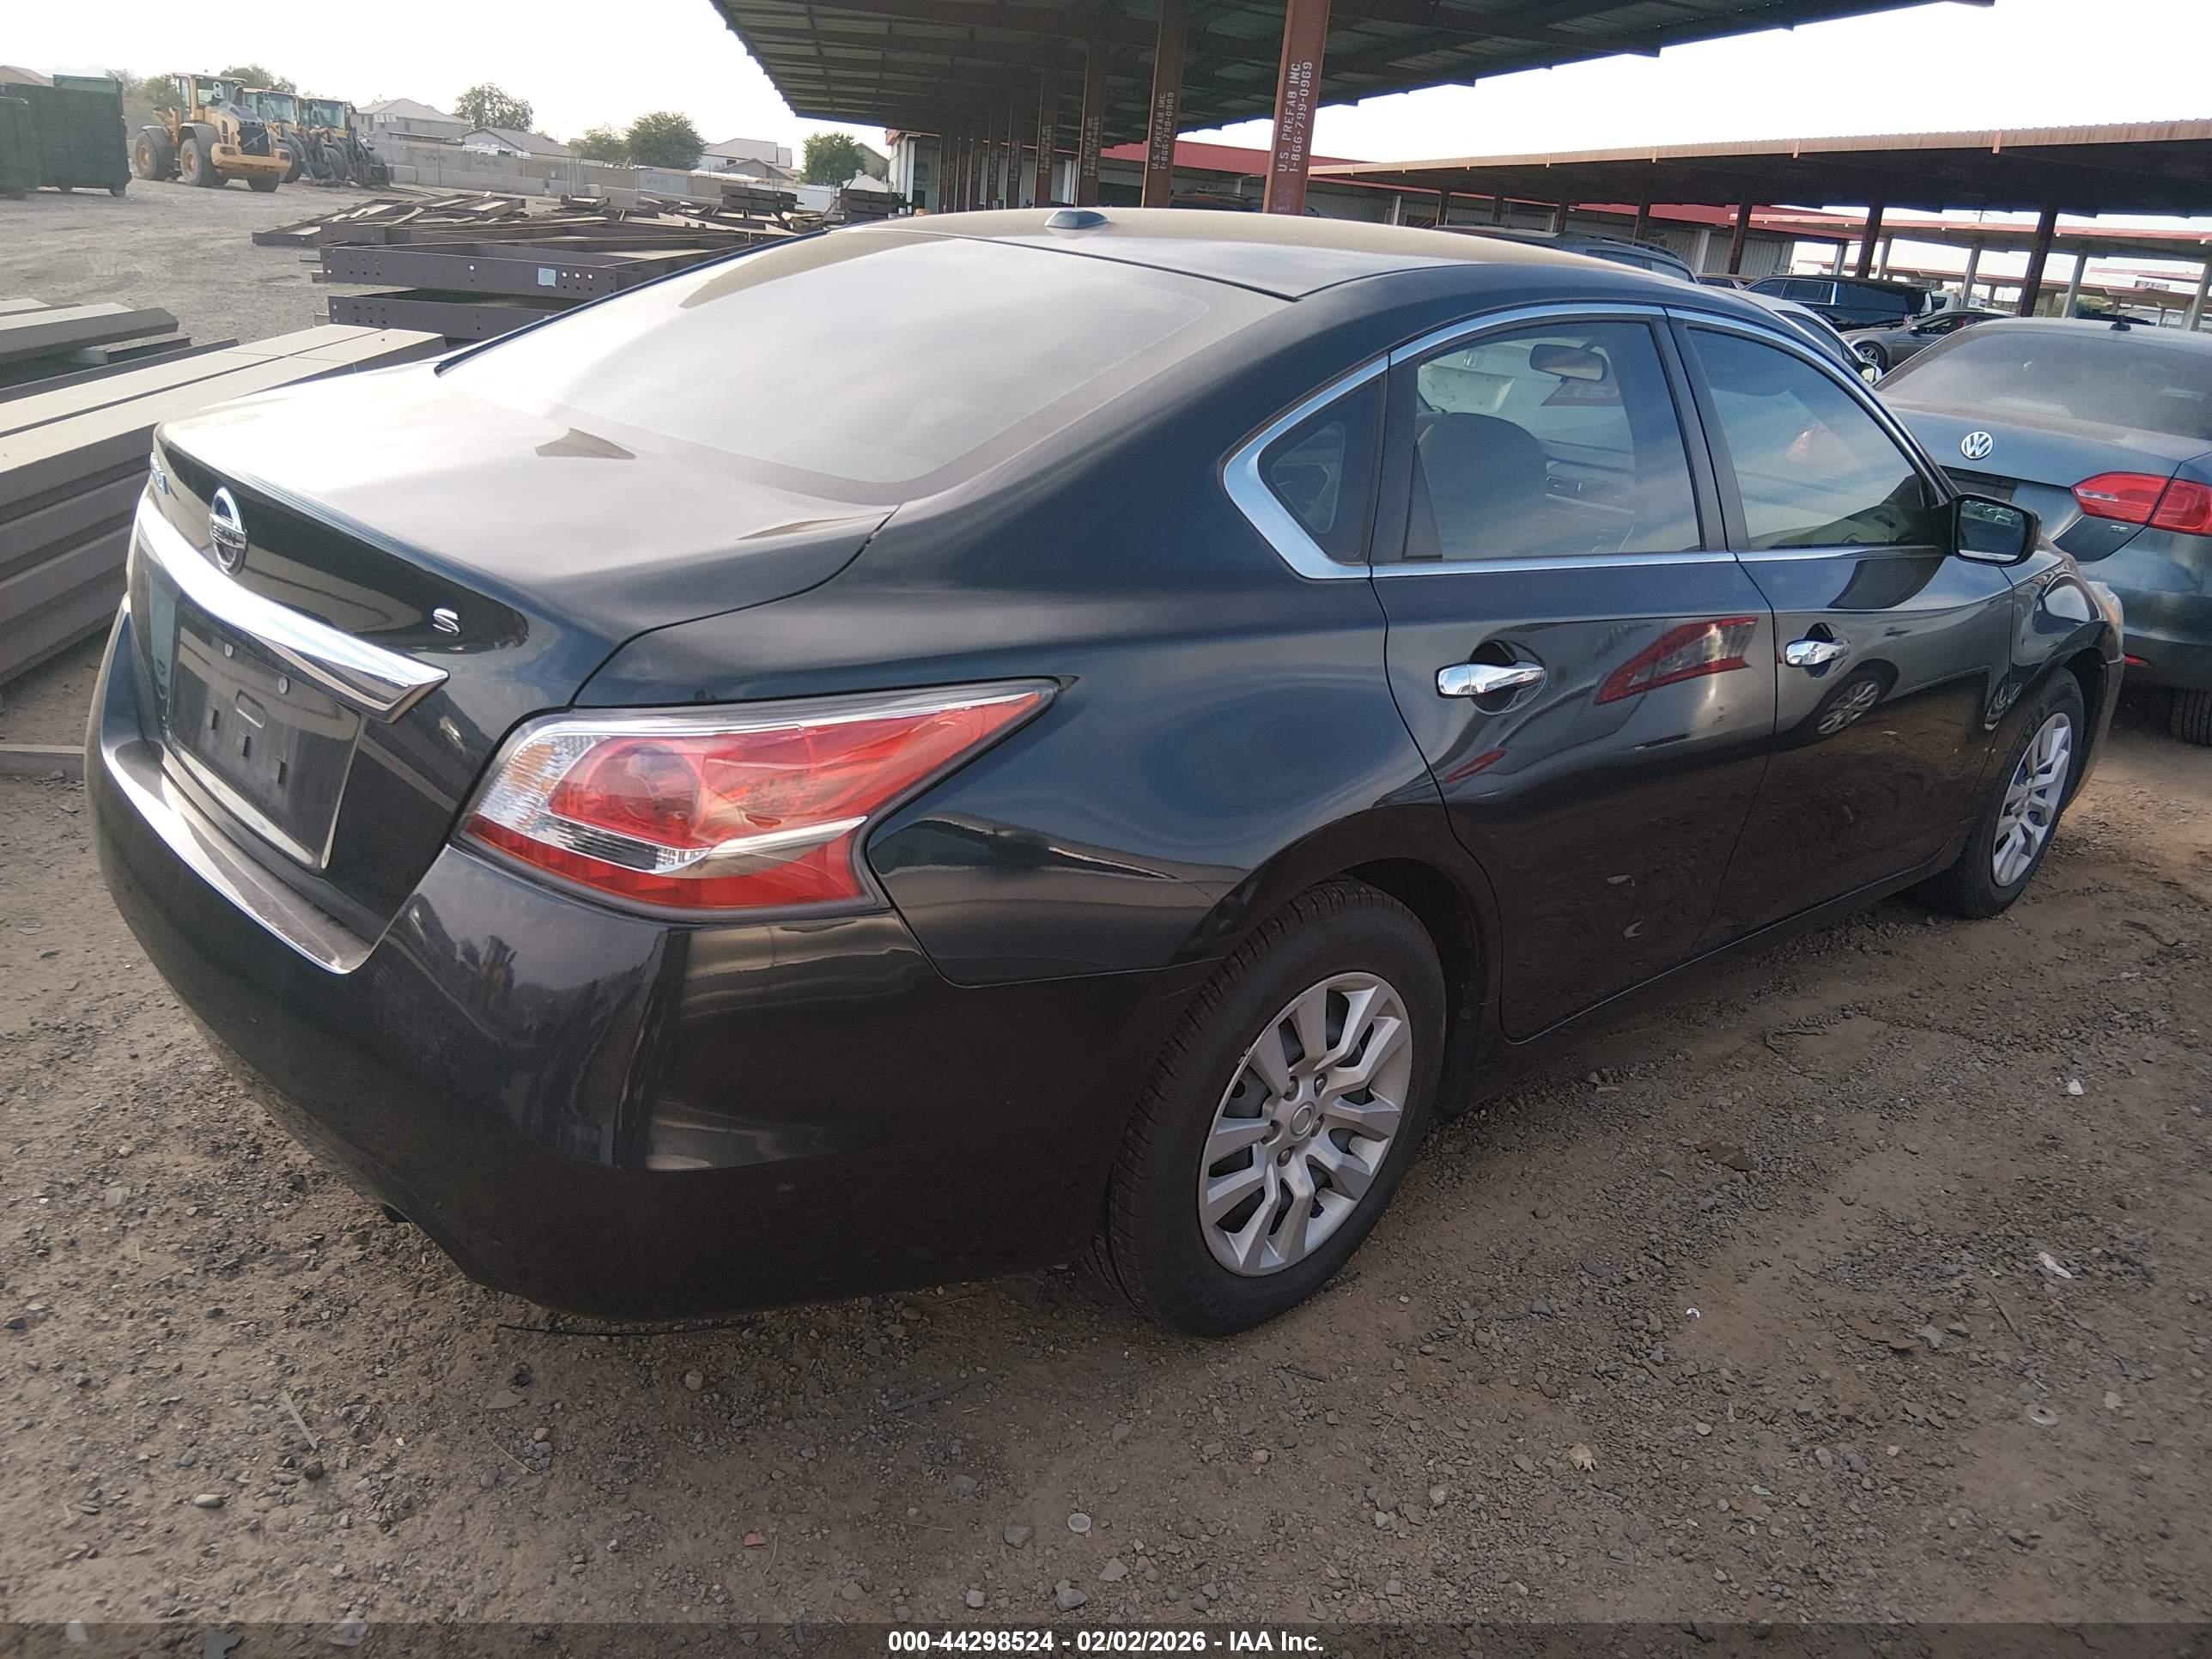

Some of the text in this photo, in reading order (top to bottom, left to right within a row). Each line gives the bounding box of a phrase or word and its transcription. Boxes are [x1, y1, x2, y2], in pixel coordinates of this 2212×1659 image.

[1281, 90, 1297, 141] PREFAB
[1289, 60, 1302, 84] INC.
[1289, 61, 1313, 173] 1-866-799-0969
[433, 608, 461, 636] S
